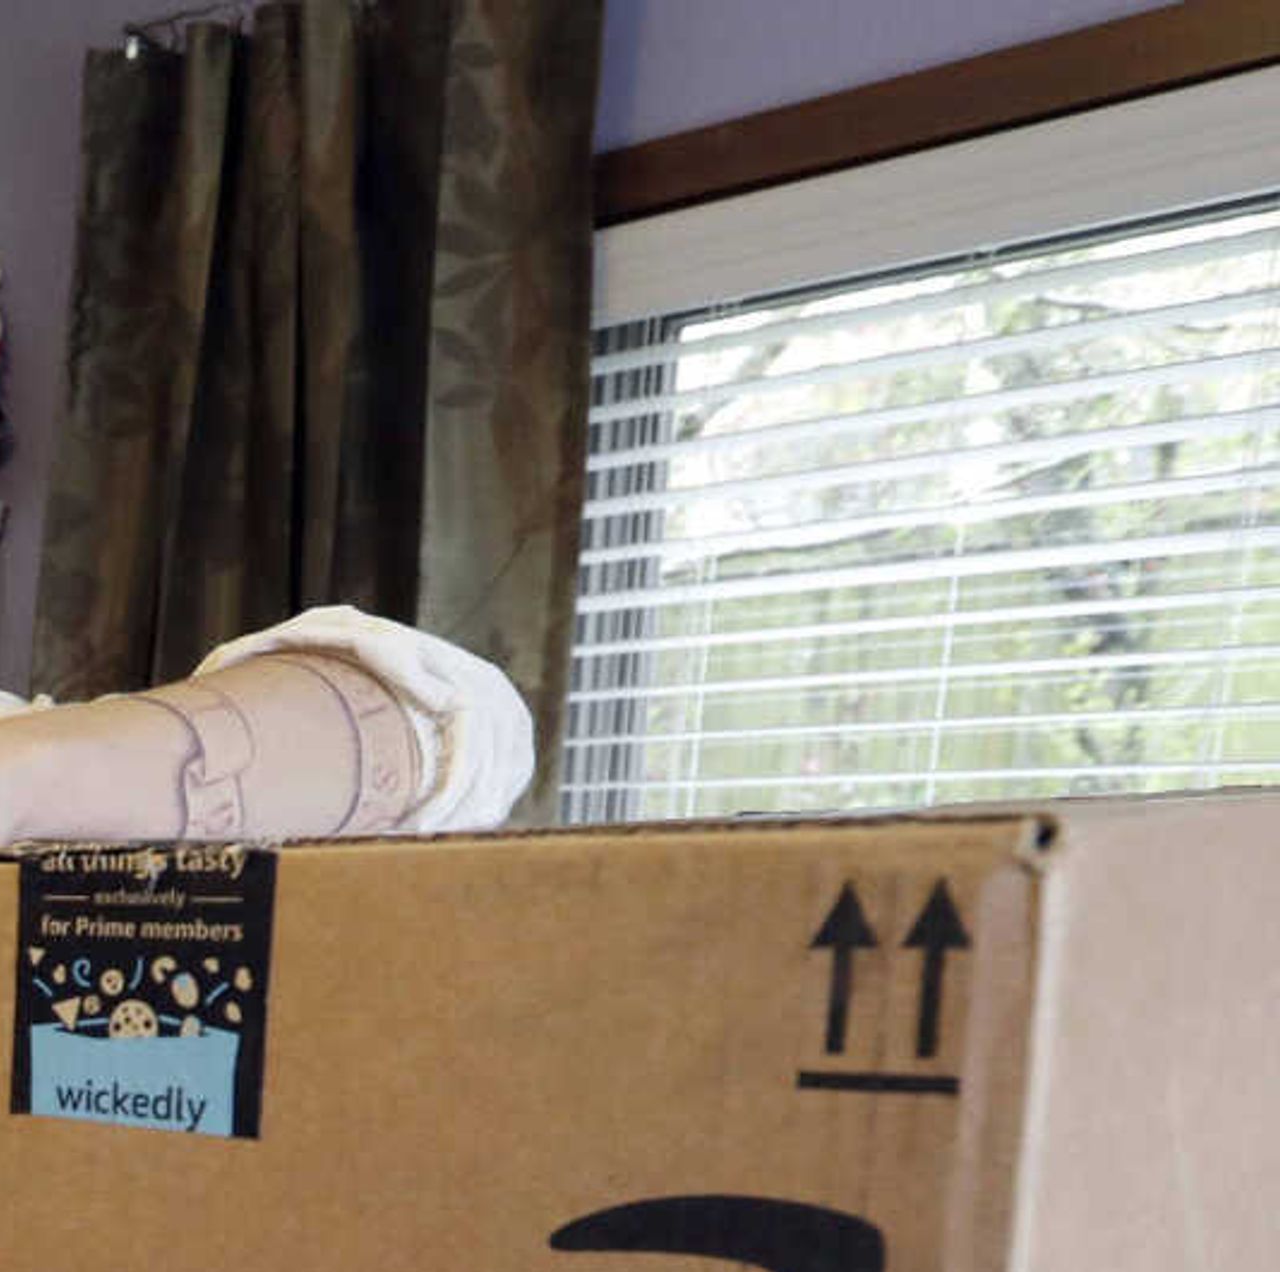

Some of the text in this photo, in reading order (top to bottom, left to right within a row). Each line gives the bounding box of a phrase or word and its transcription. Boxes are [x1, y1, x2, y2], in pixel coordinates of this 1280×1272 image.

[41, 912, 244, 942] for Prime members
[56, 1079, 207, 1133] wickedly
